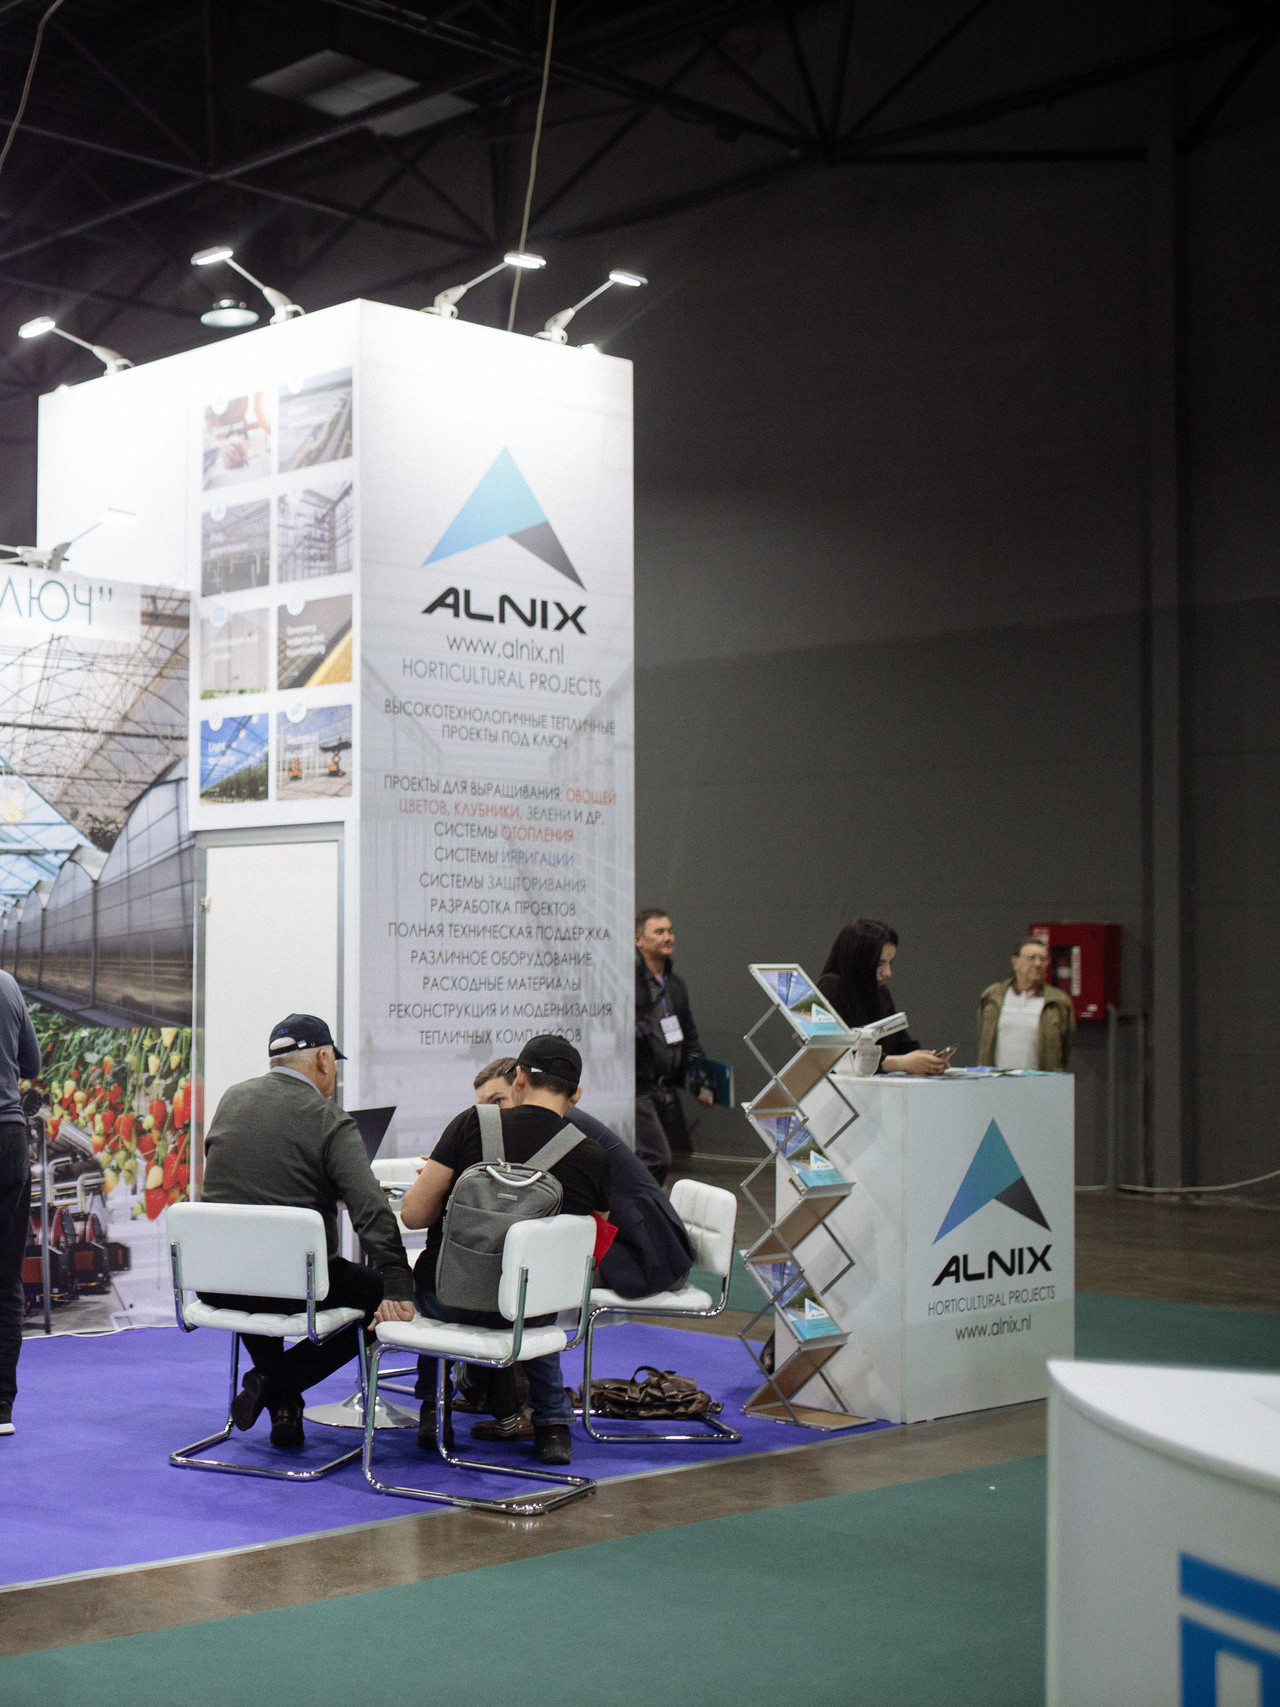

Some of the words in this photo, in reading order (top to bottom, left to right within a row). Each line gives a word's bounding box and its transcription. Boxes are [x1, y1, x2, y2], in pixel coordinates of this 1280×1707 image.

[421, 586, 588, 635] ALNIX
[446, 635, 565, 665] www.alnix.nl
[402, 658, 525, 689] HORTICULTURAL
[529, 673, 602, 698] PROJECTS
[384, 699, 548, 730] ВЫСОКОТЕХНОЛОГИЧНЫЕ
[550, 715, 616, 736] ТЕПЛИЧНЫЕ
[442, 724, 498, 743] ПРОЕКТЫ
[501, 729, 529, 748] ПОД
[532, 734, 569, 750] КЛЮЧ
[384, 774, 439, 793] ПРОЕКТЫ
[442, 779, 467, 796] ДЛЯ
[526, 805, 571, 823] ЗЕЛЕНИ
[573, 809, 583, 823] И
[434, 821, 497, 840] СИСТЕМЫ
[501, 825, 574, 844] ОТОПЛЕНИЯ
[434, 846, 498, 865] СИСТЕМЫ
[502, 849, 574, 868] ИРРИГАЦИИ
[419, 872, 484, 890] СИСТЕМЫ
[487, 874, 587, 893] ЗАШТОРИВАНИЯ
[430, 898, 510, 916] РАЗРАБОТКА
[515, 900, 576, 917] ПРОЕКТОВ
[388, 922, 444, 939] ПОЛНАЯ
[448, 923, 532, 940] ТЕХНИЧЕСКАЯ
[535, 925, 611, 942] ПОДДЕРЖКА
[410, 950, 488, 966] РАЗЛИЧНОЕ
[491, 950, 592, 968] ОБОРУДОВАНИЕ
[422, 975, 504, 992] РАСХОДНЫЕ
[507, 975, 581, 992] МАТЕРИАЛЫ
[389, 1003, 496, 1019] РЕКОНСТРУКЦИЯ
[500, 1003, 509, 1017] И
[512, 1003, 612, 1018] МОДЕРНИЗАЦИЯ
[419, 1029, 492, 1046] ТЕПЛИЧНЫХ
[931, 1244, 1053, 1287] ALNIX
[927, 1292, 1006, 1317] HORTICULTURAL
[1008, 1285, 1056, 1305] PROJECTS
[955, 1313, 1032, 1341] www.alnix.nl
